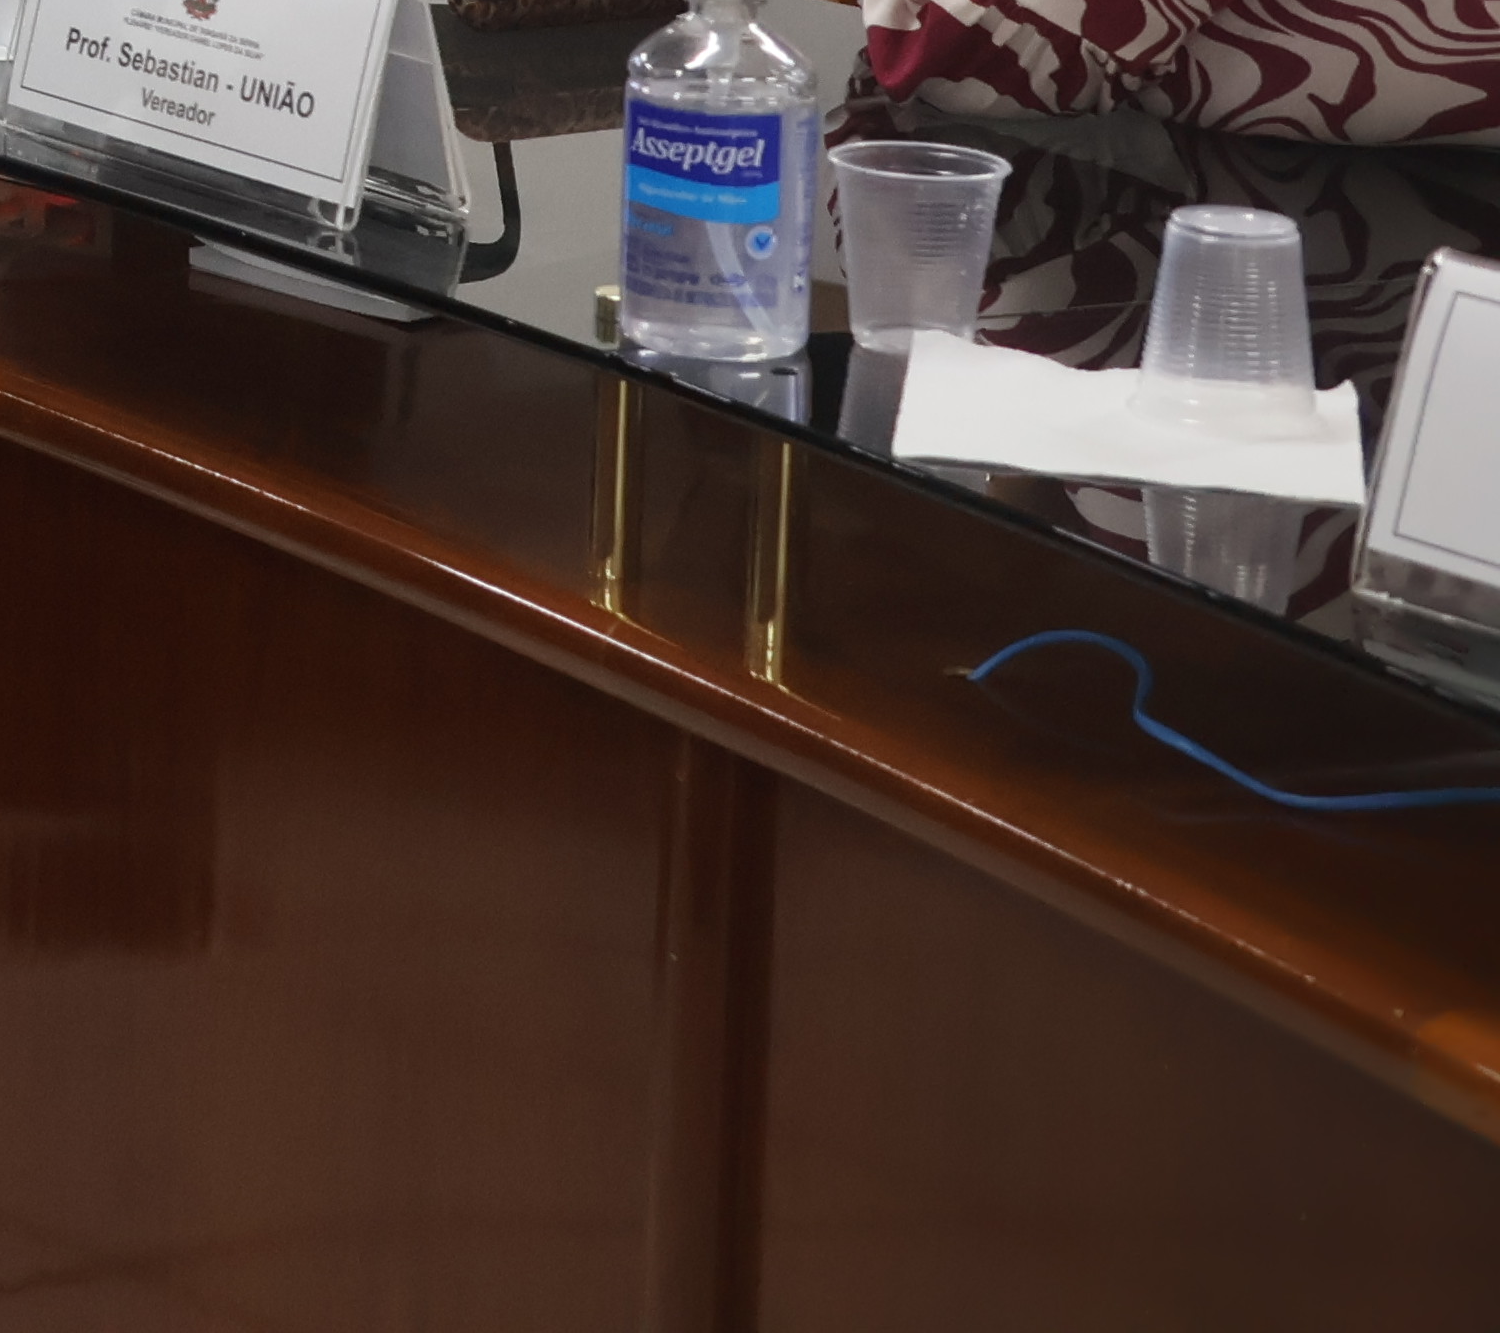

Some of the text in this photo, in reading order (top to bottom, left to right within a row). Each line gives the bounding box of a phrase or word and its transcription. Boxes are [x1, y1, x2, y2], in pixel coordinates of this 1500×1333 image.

[66, 27, 111, 62] Prof.
[118, 42, 219, 93] Sebastian
[240, 75, 315, 119] UNIÃO
[141, 87, 216, 126] Vereador
[630, 126, 766, 175] Asseptgel
